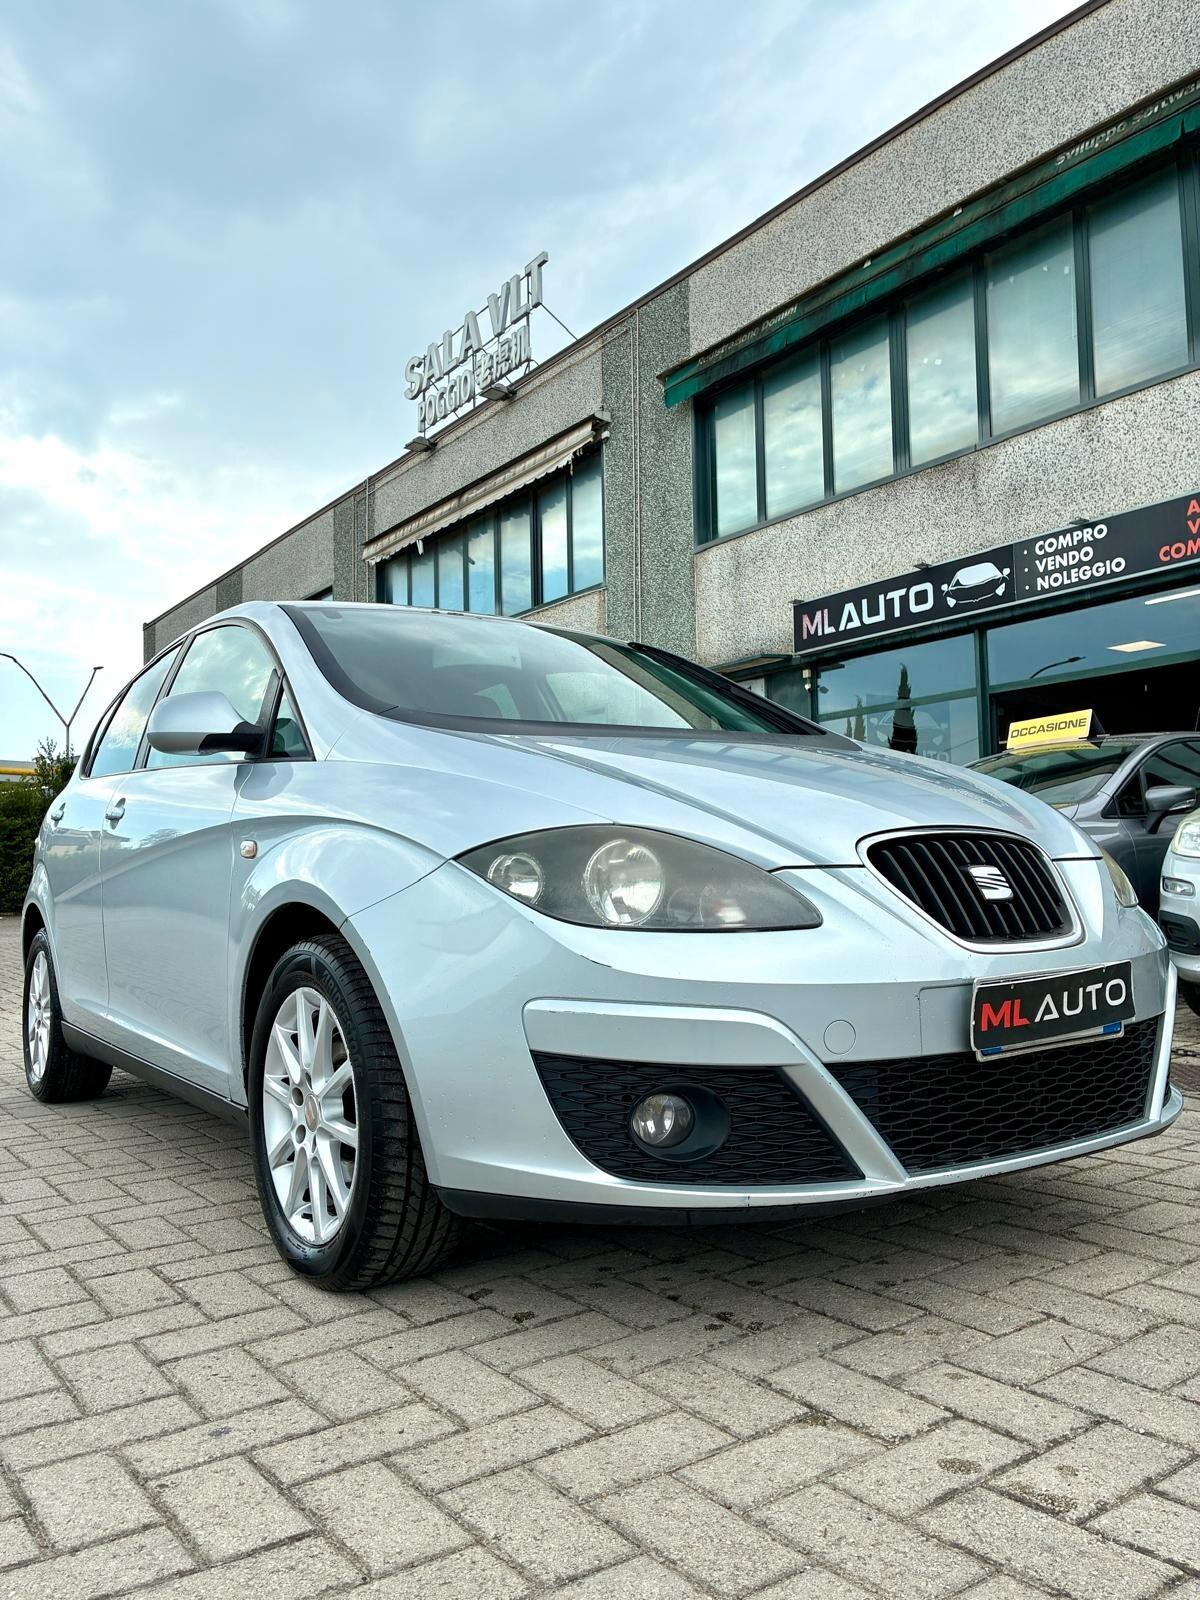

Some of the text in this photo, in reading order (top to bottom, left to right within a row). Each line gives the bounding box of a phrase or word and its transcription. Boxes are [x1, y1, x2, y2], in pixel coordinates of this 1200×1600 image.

[404, 251, 548, 400] SALA VLT
[418, 369, 475, 433] POGGIO
[1035, 524, 1108, 555] COMPRO
[1035, 546, 1094, 573] VENDO
[1037, 557, 1126, 591] NOLEGGIO
[802, 582, 934, 640] ML AUTO
[1010, 717, 1087, 738] OCCASIONE
[981, 978, 1127, 1032] ML AUTO
